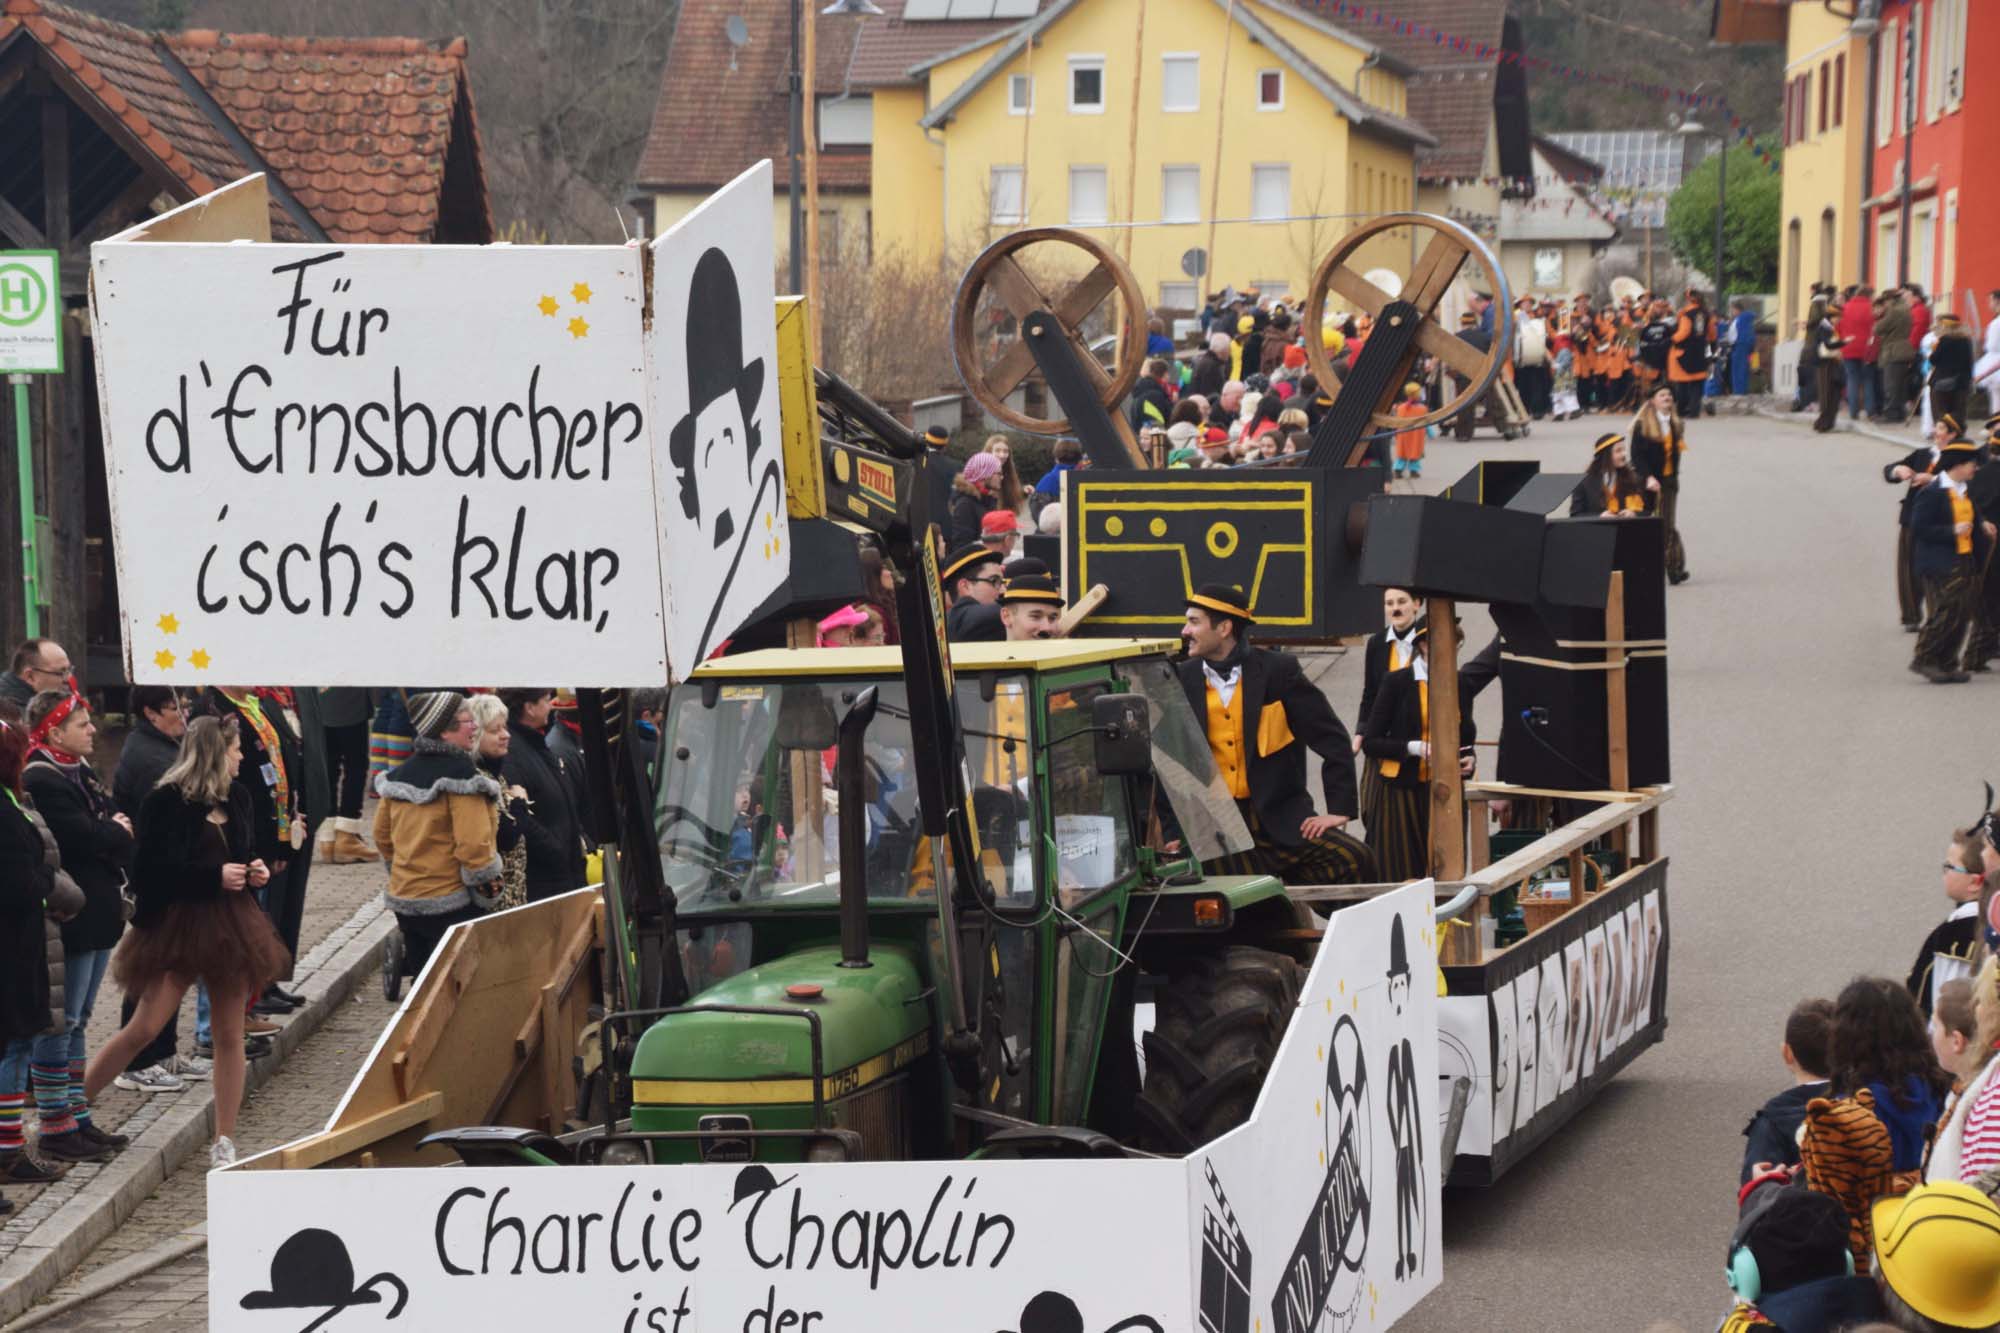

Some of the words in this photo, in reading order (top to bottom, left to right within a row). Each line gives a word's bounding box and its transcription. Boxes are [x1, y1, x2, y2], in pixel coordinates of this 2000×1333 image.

[2, 278, 31, 312] H
[272, 252, 389, 356] Für
[146, 361, 643, 481] d'Ernsbacher
[197, 500, 413, 619] isch's
[451, 495, 620, 633] klar,
[434, 1181, 701, 1275] Charlie
[741, 1176, 1014, 1290] Chaplin
[623, 1286, 691, 1333] ist
[743, 1285, 824, 1333] der
